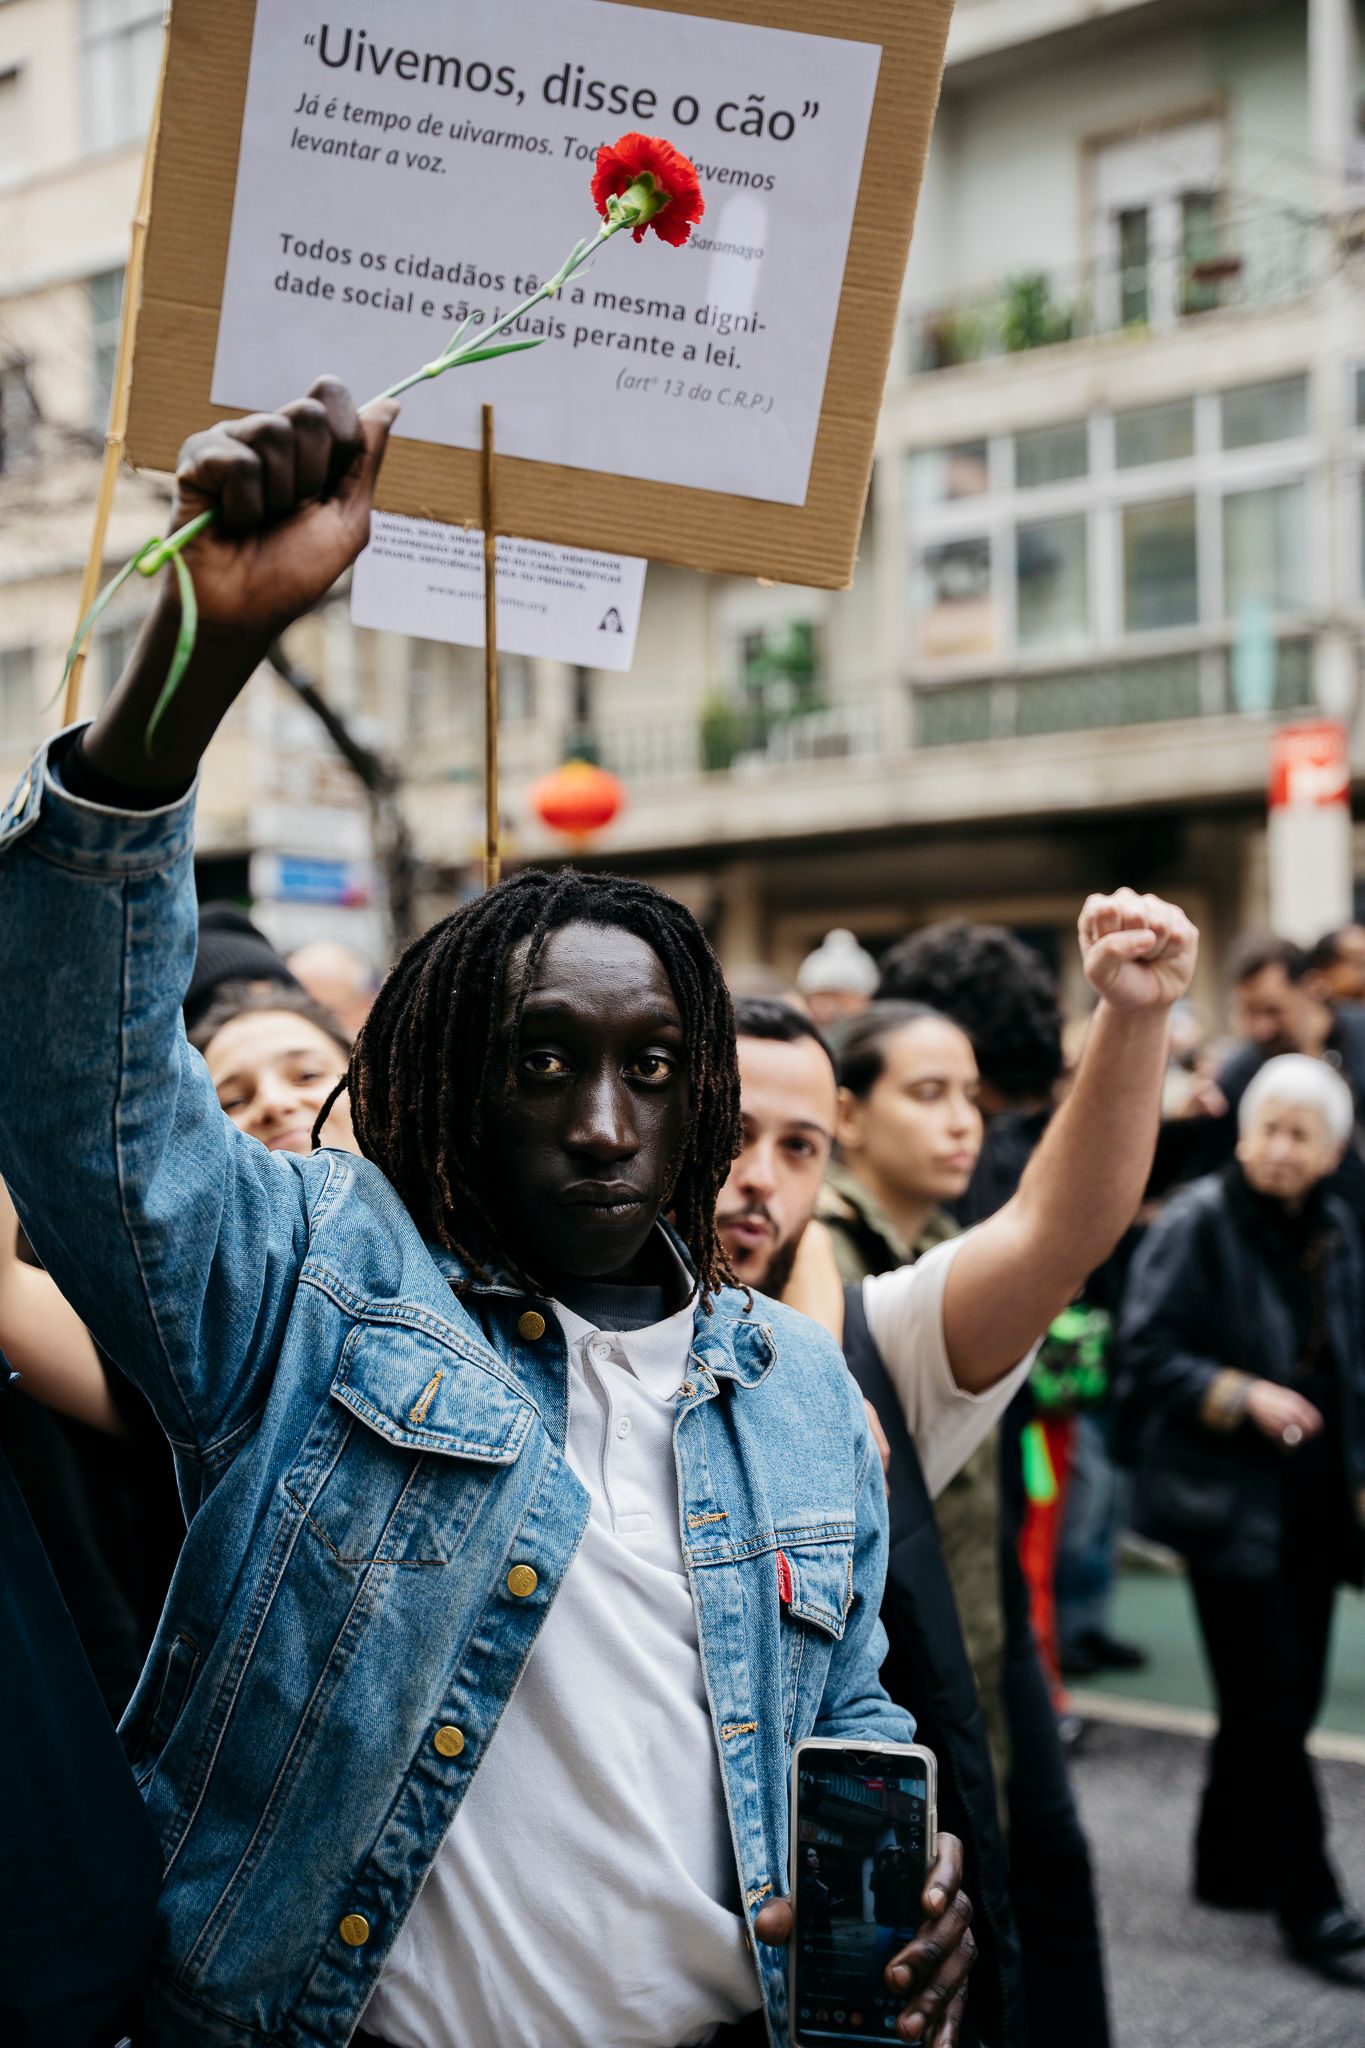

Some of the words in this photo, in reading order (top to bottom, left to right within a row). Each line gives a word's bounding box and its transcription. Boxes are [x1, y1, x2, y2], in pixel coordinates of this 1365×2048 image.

[302, 23, 527, 108] “Uivemos,
[541, 61, 659, 121] disse
[670, 94, 701, 128] o
[713, 94, 821, 143] cão”
[289, 126, 383, 163] levantar
[384, 148, 401, 167] a
[405, 151, 447, 175] voz.
[293, 91, 321, 117] Já
[324, 97, 339, 120] é
[342, 100, 413, 134] tempo
[415, 111, 445, 138] de
[448, 119, 554, 157] uivarmos.
[562, 135, 604, 162] Tod
[689, 155, 777, 193] evemos
[278, 231, 353, 268] Todos
[358, 251, 388, 272] os
[393, 254, 506, 292] cidadãos
[569, 286, 586, 306] a
[592, 290, 687, 323] mesma
[693, 303, 767, 336] digni-
[688, 232, 765, 261] Saramago
[273, 269, 337, 301] dade
[341, 285, 415, 315] social
[419, 299, 436, 318] e
[442, 300, 484, 326] são
[571, 325, 676, 362] perante
[681, 343, 698, 362] a
[704, 340, 743, 371] lei.
[663, 378, 686, 399] 13
[687, 383, 713, 402] da
